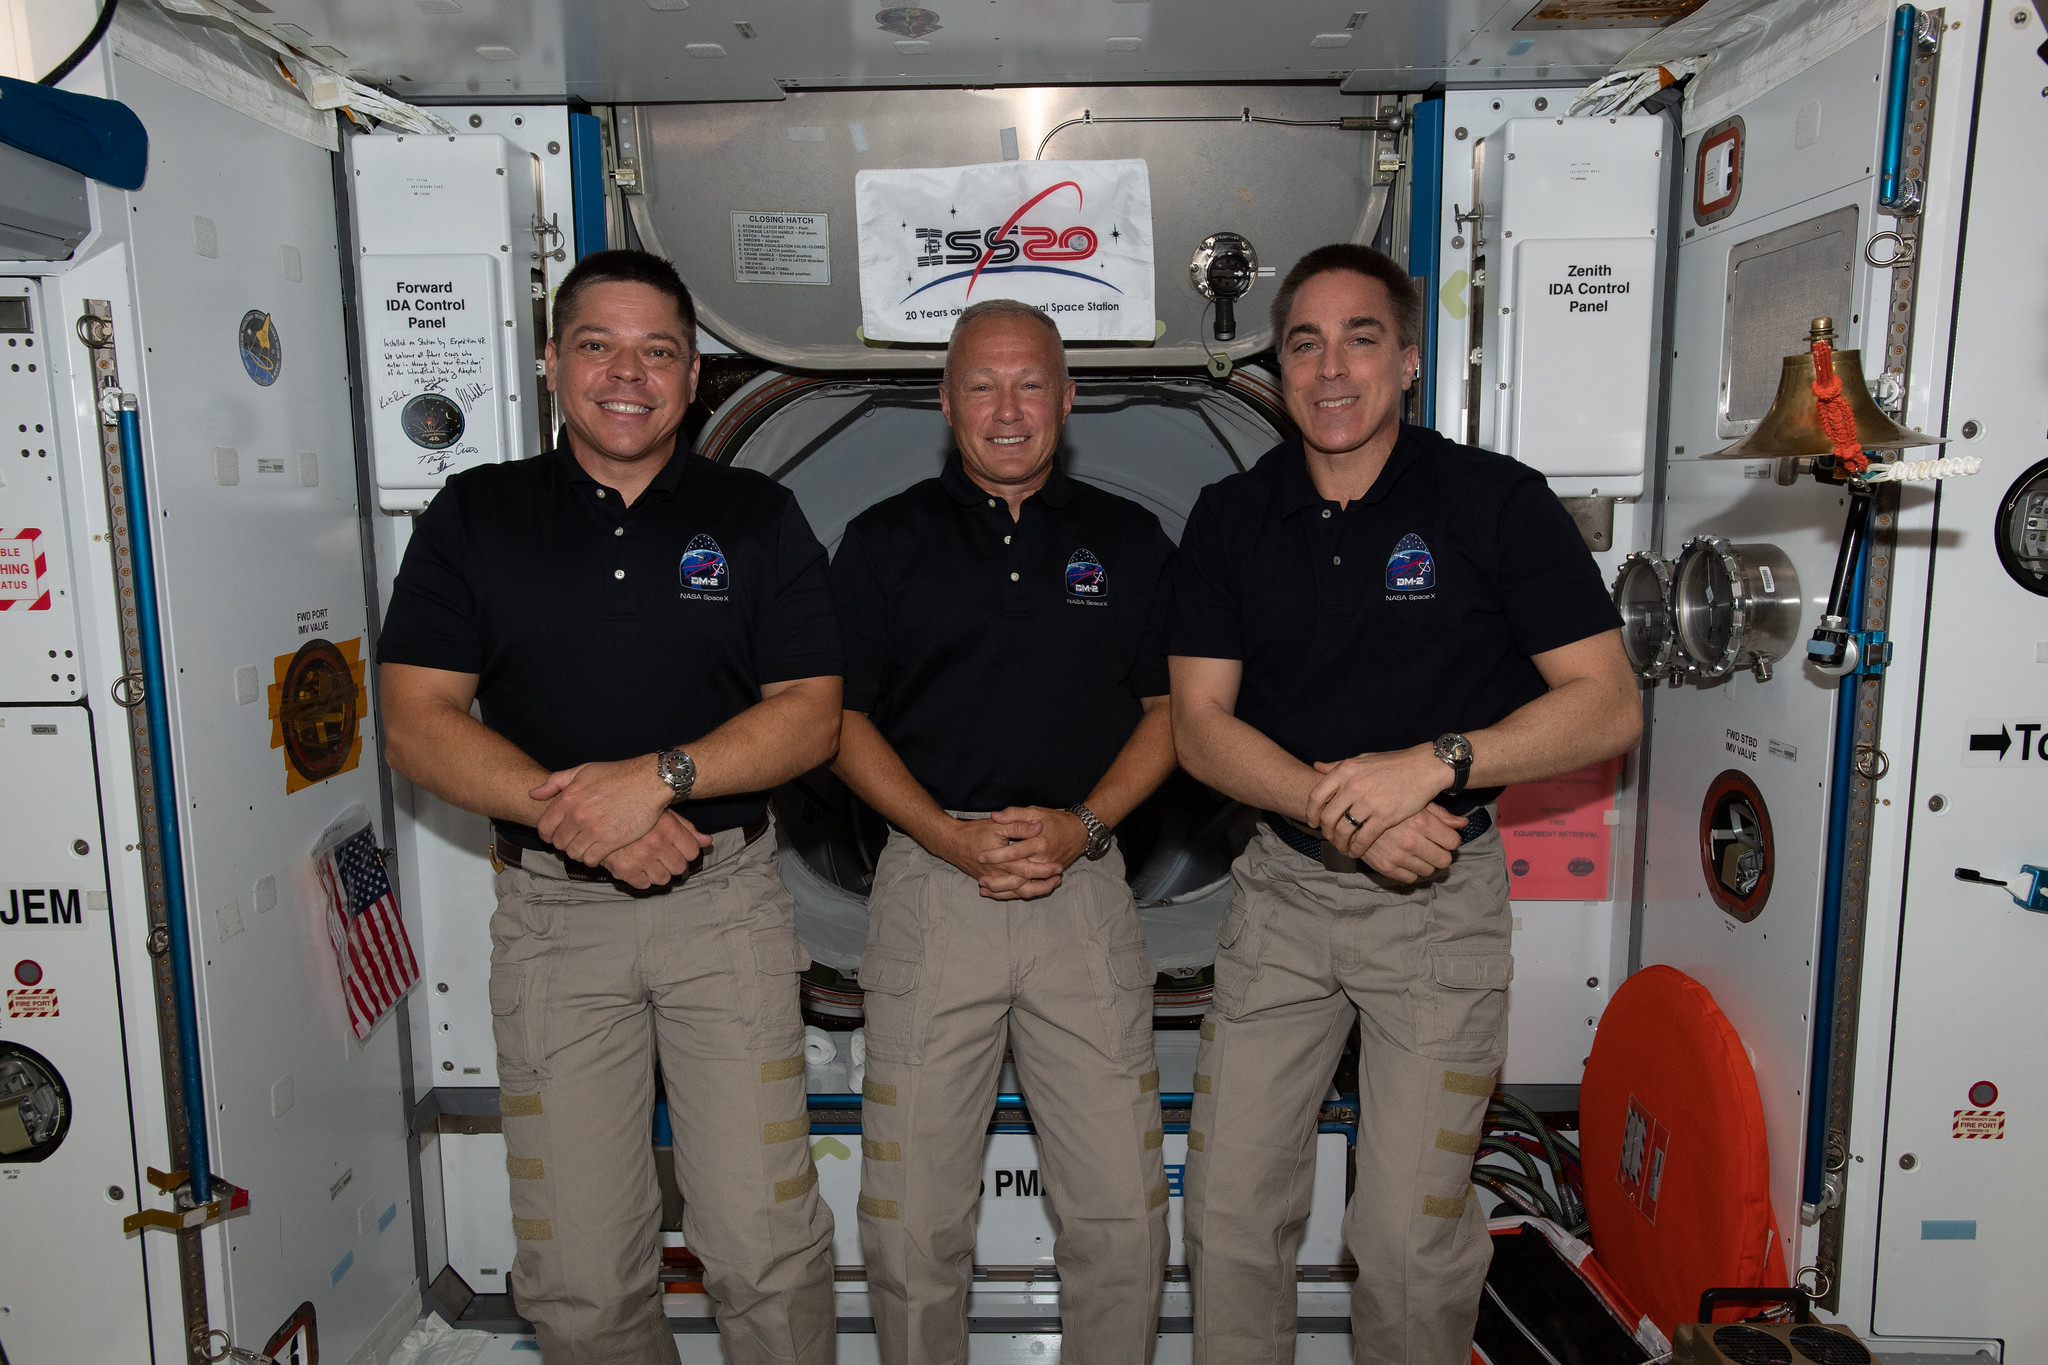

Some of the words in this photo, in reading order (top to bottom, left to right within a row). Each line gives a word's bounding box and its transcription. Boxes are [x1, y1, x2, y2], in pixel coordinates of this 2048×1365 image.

[1568, 264, 1612, 277] Zenith
[397, 281, 452, 293] Forward
[1549, 283, 1573, 295] IDA
[1578, 282, 1630, 294] Control
[386, 300, 411, 311] IDA
[415, 299, 465, 311] Control
[1570, 300, 1608, 312] Panel
[905, 311, 917, 321] 20
[920, 309, 947, 319] Years
[1051, 303, 1084, 313] Space
[1088, 302, 1119, 311] Station
[408, 317, 446, 328] Panel
[384, 338, 406, 347] Installed
[438, 338, 445, 348] by
[450, 338, 477, 347] Expedition
[426, 349, 440, 358] future
[0, 548, 20, 557] BLE
[0, 564, 30, 574] HING
[1, 581, 28, 589] ATUS
[691, 576, 718, 586] DM-2
[1397, 577, 1424, 586] DM-2
[297, 611, 311, 622] FWD
[312, 608, 328, 619] PORT
[298, 624, 309, 635] IMV
[310, 621, 329, 633] VALVE
[1726, 729, 1739, 741] FWD
[1740, 734, 1757, 747] STBD
[1726, 742, 1736, 753] IMV
[1738, 746, 1756, 762] VALVE
[0, 889, 82, 925] JEM
[995, 1169, 1047, 1196] PM
